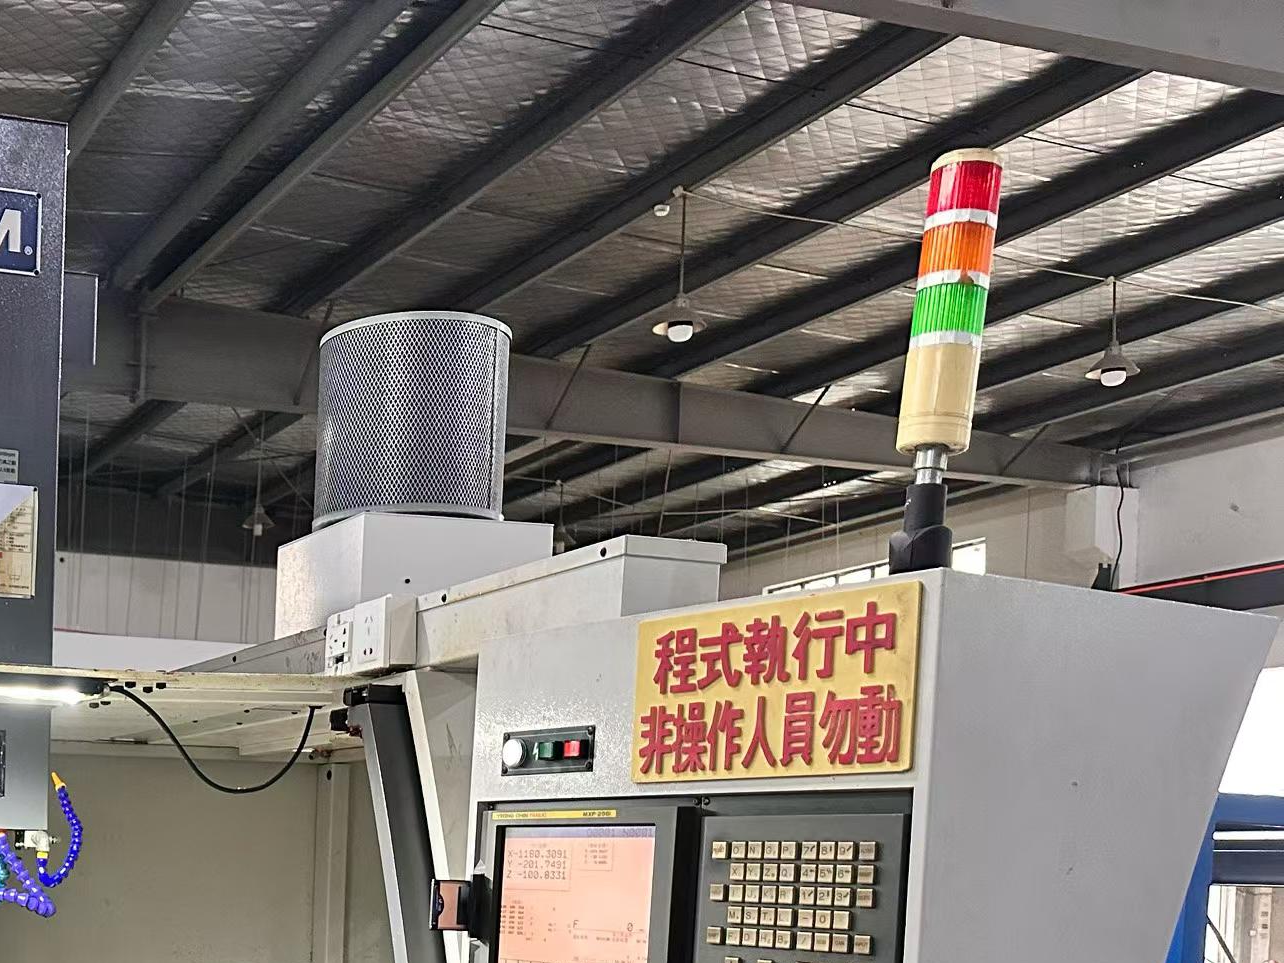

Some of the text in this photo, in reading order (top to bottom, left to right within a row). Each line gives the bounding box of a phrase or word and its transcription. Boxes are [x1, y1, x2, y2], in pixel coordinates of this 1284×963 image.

[652, 601, 897, 694] 程式執行中
[639, 684, 902, 774] 非操作人員勿動
